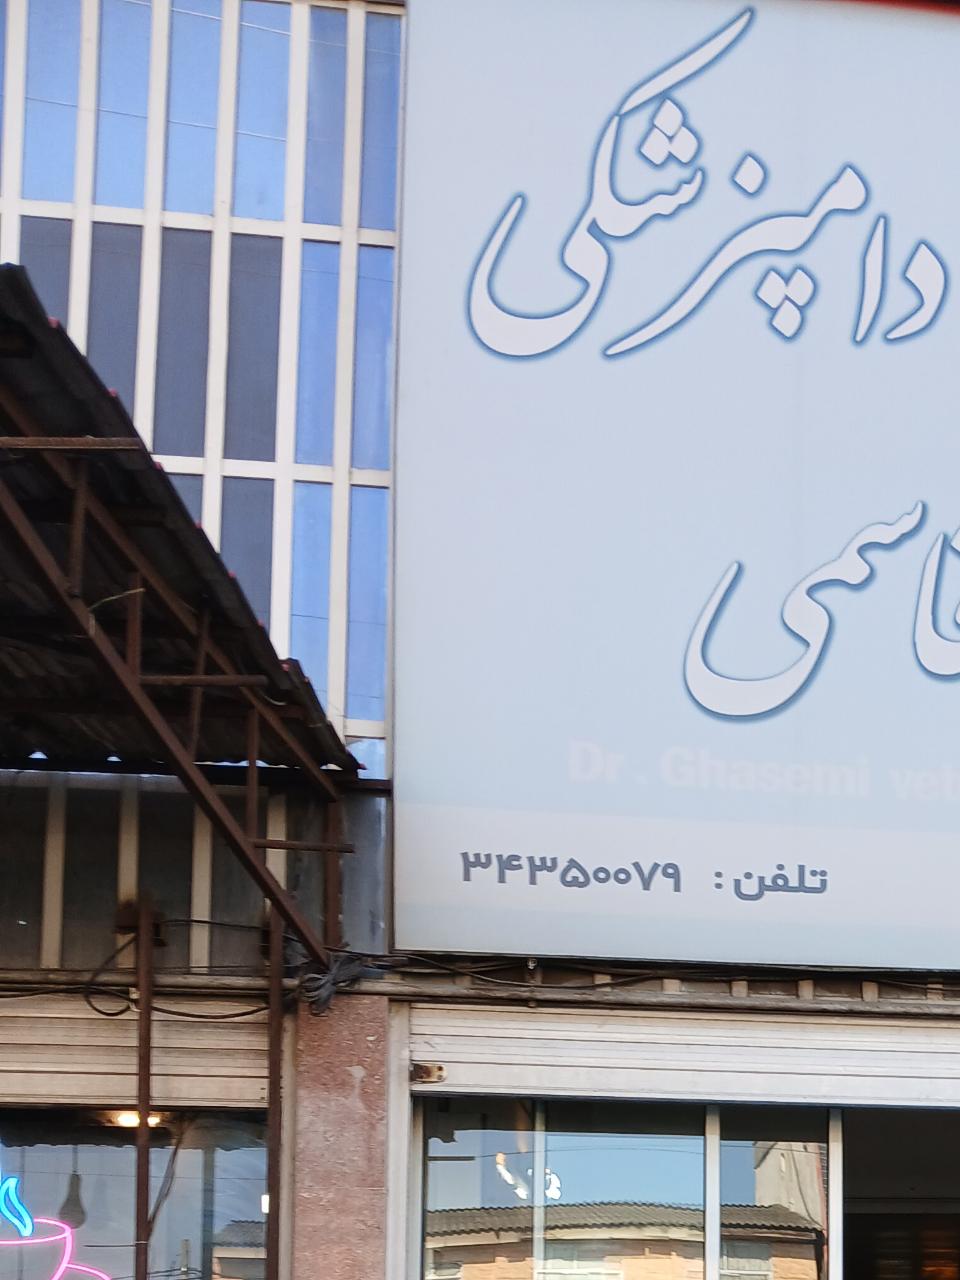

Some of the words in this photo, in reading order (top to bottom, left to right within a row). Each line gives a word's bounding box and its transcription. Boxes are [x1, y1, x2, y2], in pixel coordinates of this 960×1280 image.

[467, 6, 949, 359] دامپزشکی
[659, 744, 870, 798] Ghasemi
[460, 850, 682, 893] ۳۴۳۵۰۰۷۹
